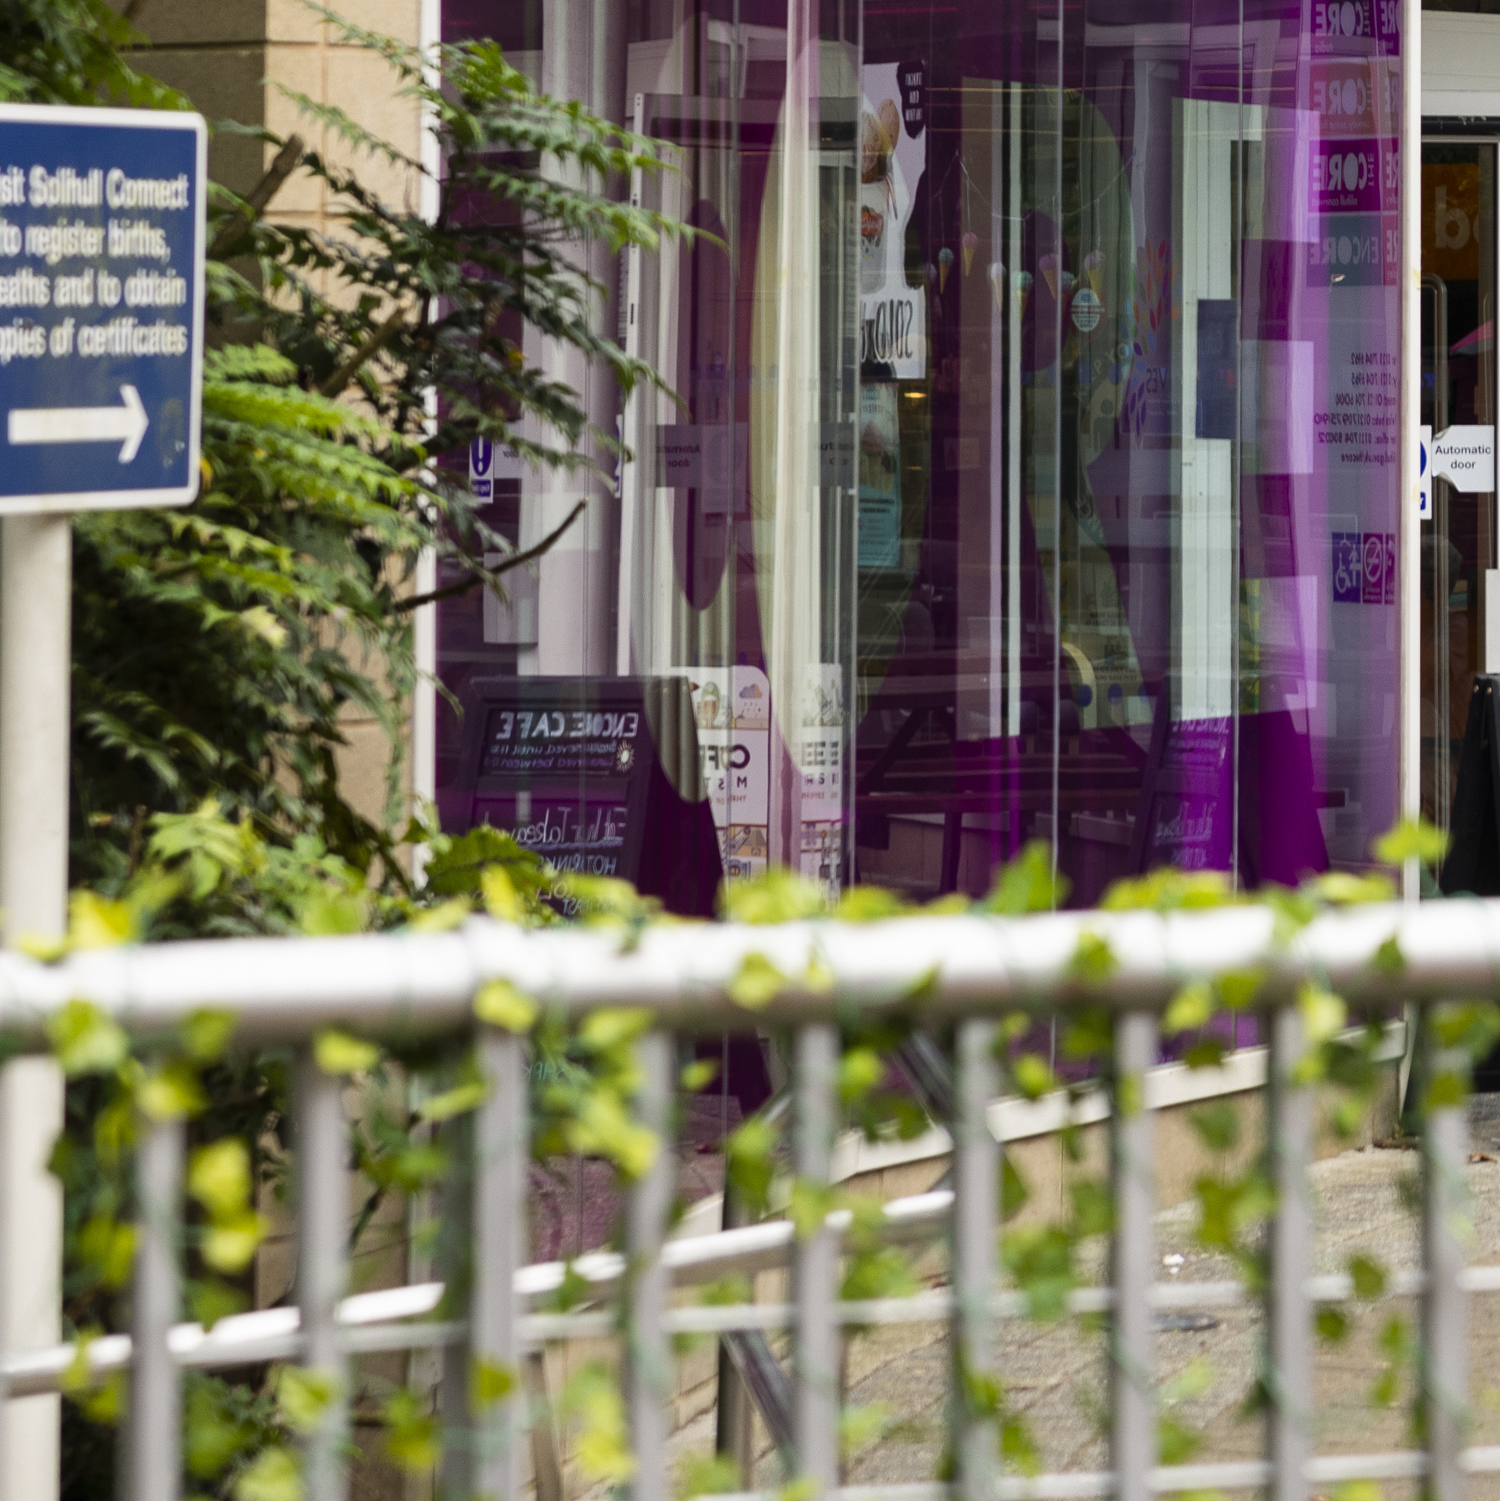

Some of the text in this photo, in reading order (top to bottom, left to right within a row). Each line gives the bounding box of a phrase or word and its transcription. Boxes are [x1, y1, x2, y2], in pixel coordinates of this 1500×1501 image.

[29, 165, 189, 210] Solihull Connect
[25, 217, 105, 265] register
[0, 267, 187, 307] eaths and to obtain
[50, 317, 188, 358] of certificates
[1435, 445, 1491, 456] Automatic
[1450, 460, 1476, 470] door
